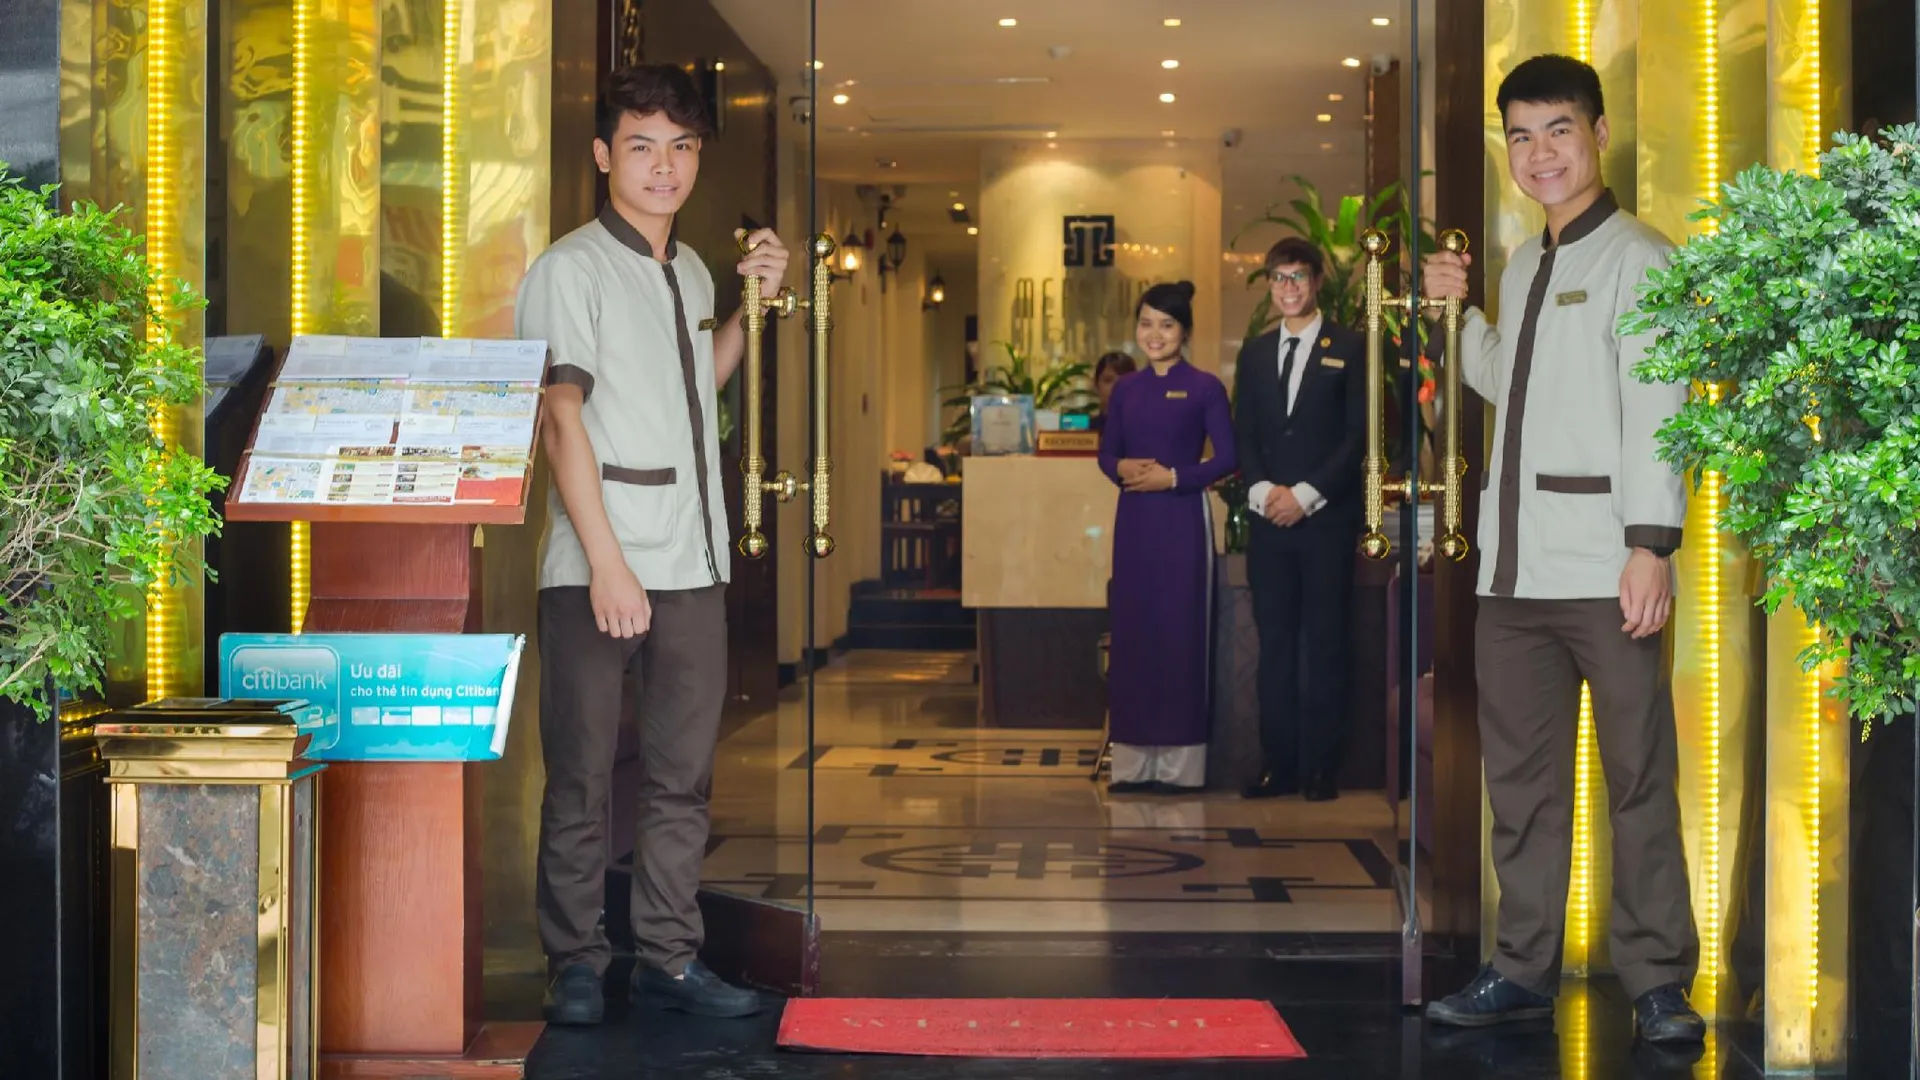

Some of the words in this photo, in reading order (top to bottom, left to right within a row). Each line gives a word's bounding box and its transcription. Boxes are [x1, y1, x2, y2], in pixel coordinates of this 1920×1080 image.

[242, 666, 327, 690] citibank
[350, 685, 373, 697] cho
[456, 684, 500, 697] Citiban
